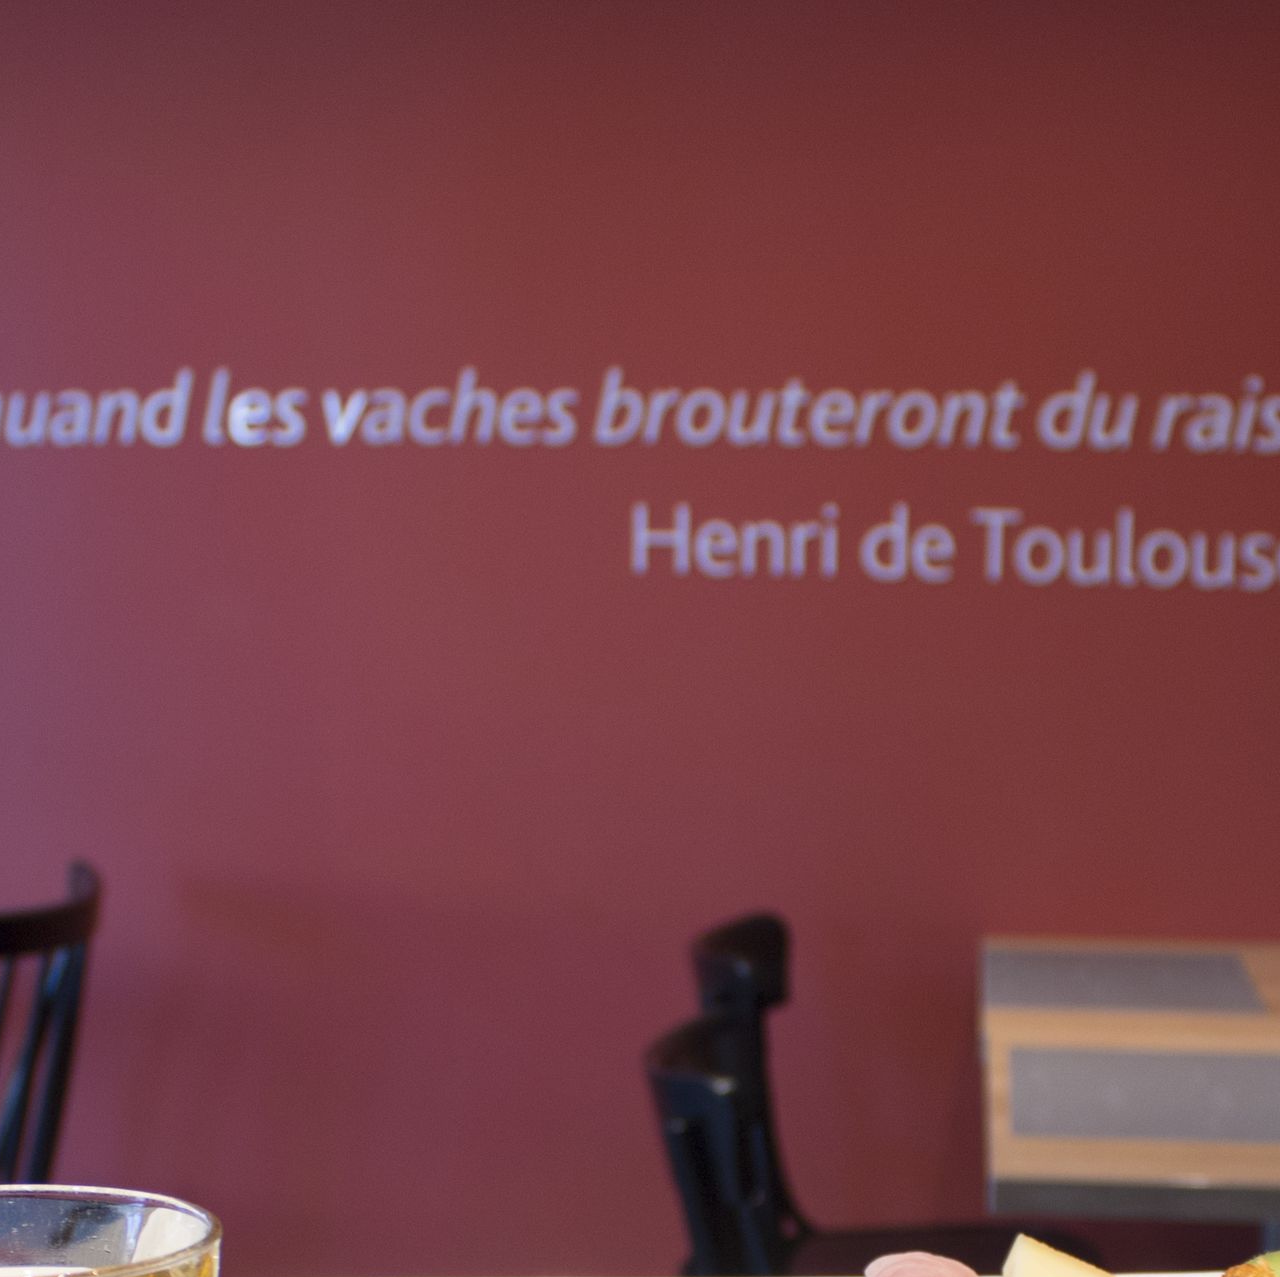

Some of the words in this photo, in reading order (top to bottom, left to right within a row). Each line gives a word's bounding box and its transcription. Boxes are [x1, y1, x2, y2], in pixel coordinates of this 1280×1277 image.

[203, 369, 306, 447] les
[322, 368, 576, 446] vaches
[594, 368, 1023, 448] brouteront
[1038, 372, 1137, 449] du
[631, 503, 836, 577] Henri
[861, 505, 954, 582] de
